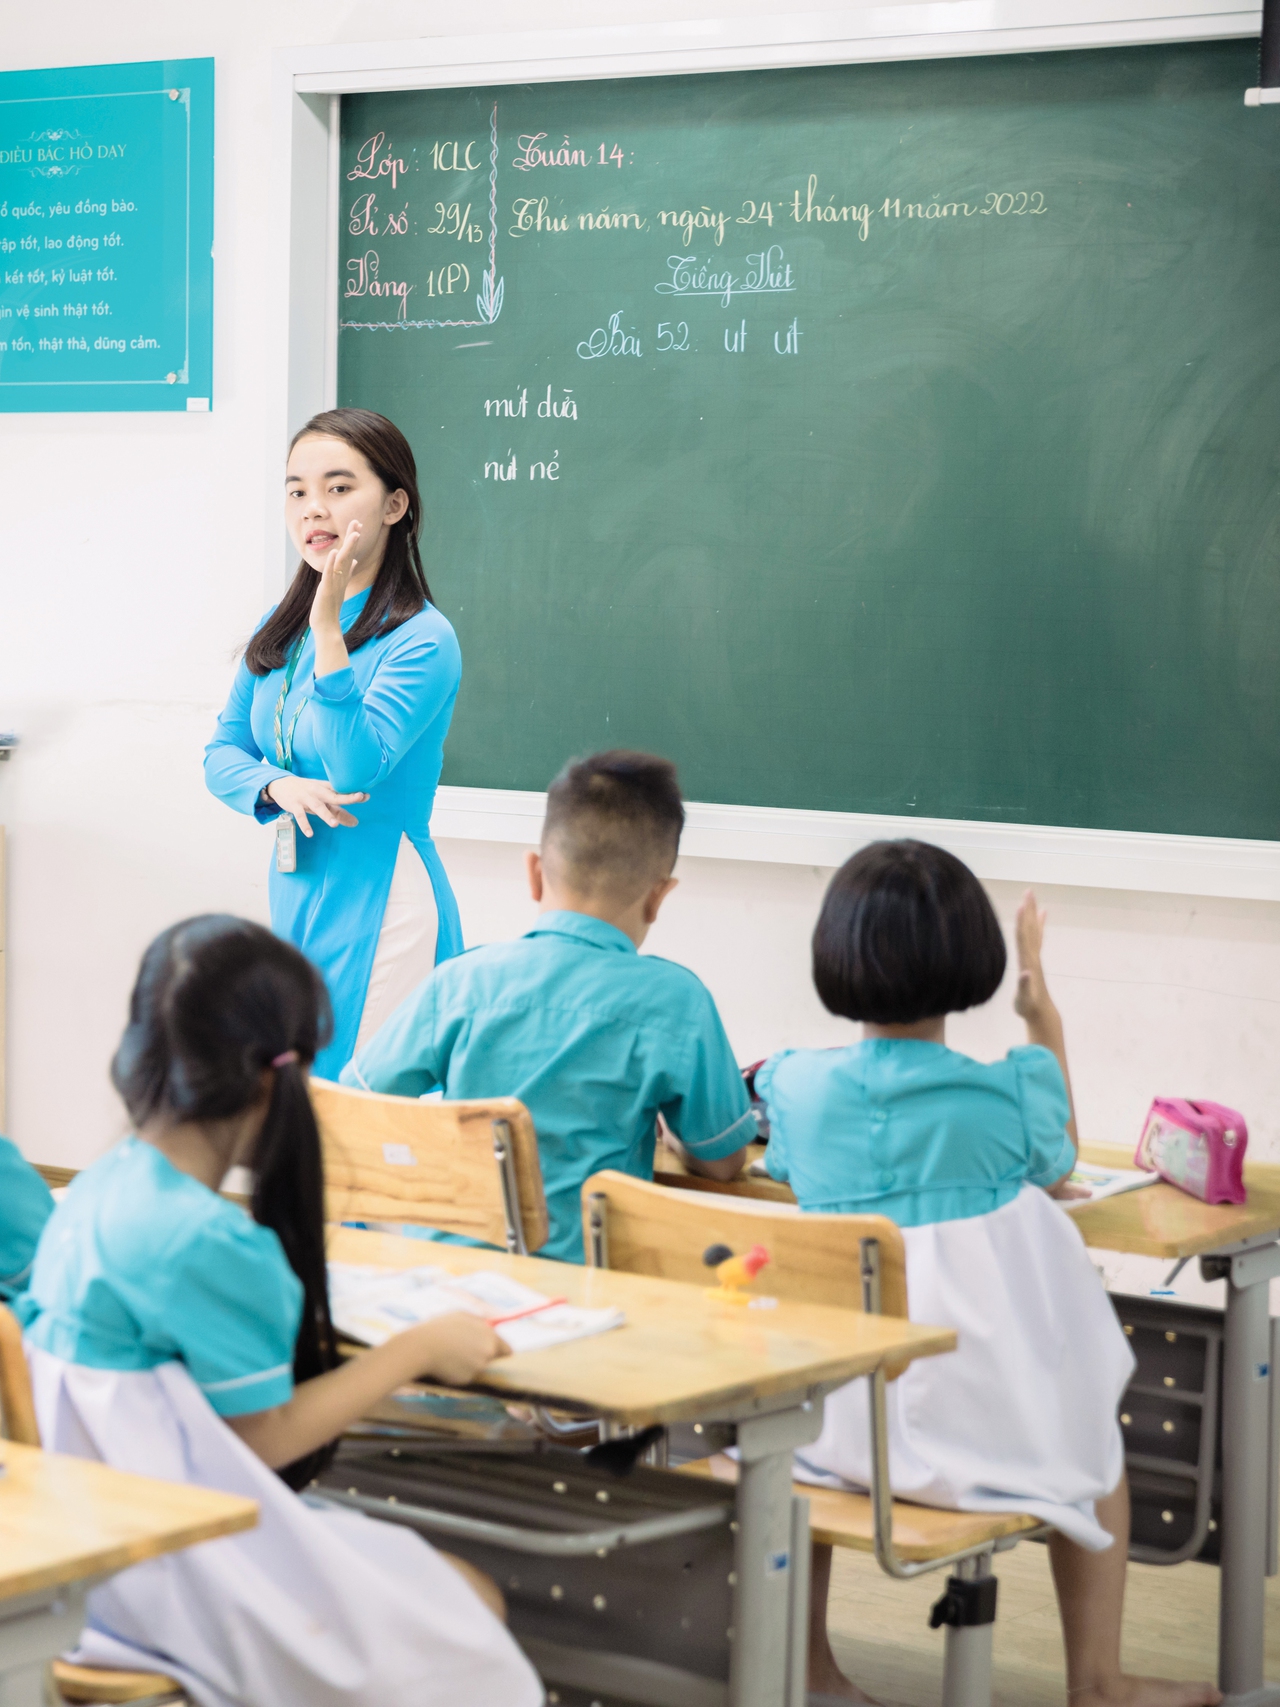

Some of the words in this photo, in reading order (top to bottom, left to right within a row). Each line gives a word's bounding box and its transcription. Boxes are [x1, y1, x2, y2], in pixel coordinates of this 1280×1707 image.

[38, 145, 65, 162] BÁC
[97, 144, 127, 161] DẠY
[512, 132, 592, 172] Tuần
[12, 201, 45, 220] quốc,
[49, 202, 71, 218] yêu
[74, 199, 107, 217] đồng
[111, 199, 138, 213] bào.
[657, 205, 731, 247] ngày
[735, 200, 775, 227] 24
[789, 173, 873, 241] tháng
[878, 198, 901, 219] 11
[901, 193, 978, 220] năm
[979, 191, 1048, 216] 2022
[20, 235, 41, 252] tốt,
[44, 236, 63, 249] lao
[66, 235, 99, 250] động
[103, 232, 124, 247] tốt.
[5, 269, 24, 284] kết
[27, 268, 48, 286] tốt,
[51, 268, 66, 285] kỷ
[69, 269, 93, 285] luật
[96, 266, 118, 282] tốt.
[654, 255, 739, 309] Tiếng
[16, 304, 30, 320] vệ
[34, 304, 59, 317] sinh
[63, 303, 88, 319] thật
[91, 301, 113, 316] tốt.
[11, 336, 34, 353] tốn,
[38, 337, 64, 353] thật
[67, 337, 90, 353] thà,
[94, 336, 126, 353] dũng
[130, 334, 161, 349] cảm.
[576, 310, 644, 360] Bài
[724, 319, 747, 353] ut
[529, 449, 560, 481] nẻ
